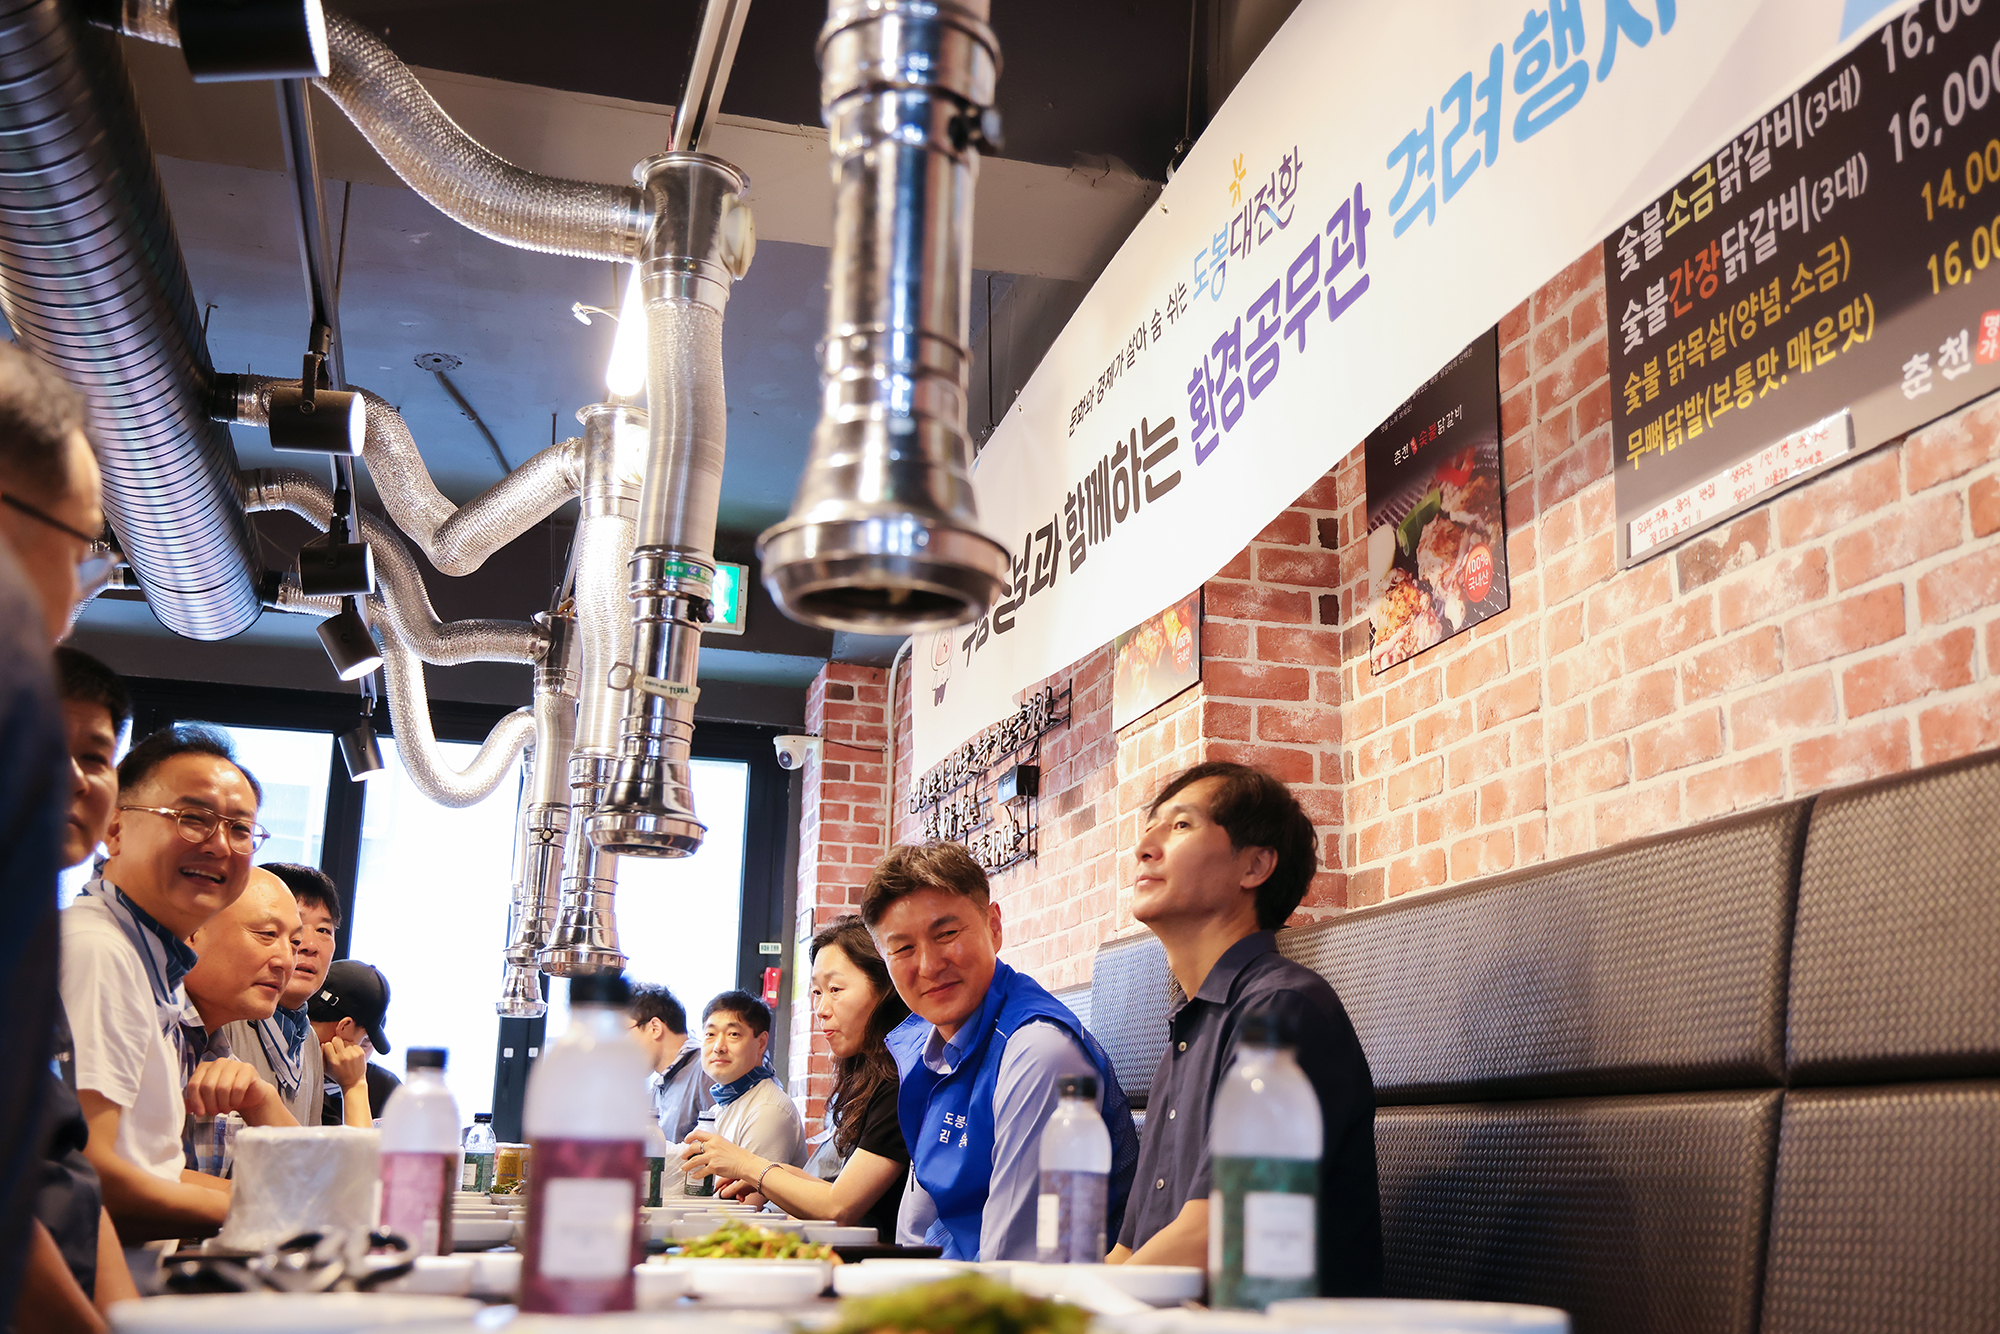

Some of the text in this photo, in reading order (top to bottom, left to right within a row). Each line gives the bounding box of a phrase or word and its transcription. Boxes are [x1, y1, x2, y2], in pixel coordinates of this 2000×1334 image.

[1069, 385, 1094, 438] 문화와
[1097, 349, 1124, 404] 경제가
[1126, 321, 1147, 369] 살아
[1151, 308, 1162, 343] 숨
[1166, 281, 1187, 325] 쉬는
[1064, 416, 1181, 574] 함께하는
[1187, 182, 1371, 466] 환경공무관
[1623, 356, 1661, 415] 숯불
[1393, 443, 1409, 466] 춘천
[1468, 552, 1488, 574] 100%
[1468, 569, 1488, 591] 국내산
[943, 1112, 968, 1129] 도봉
[939, 1129, 951, 1144] 김
